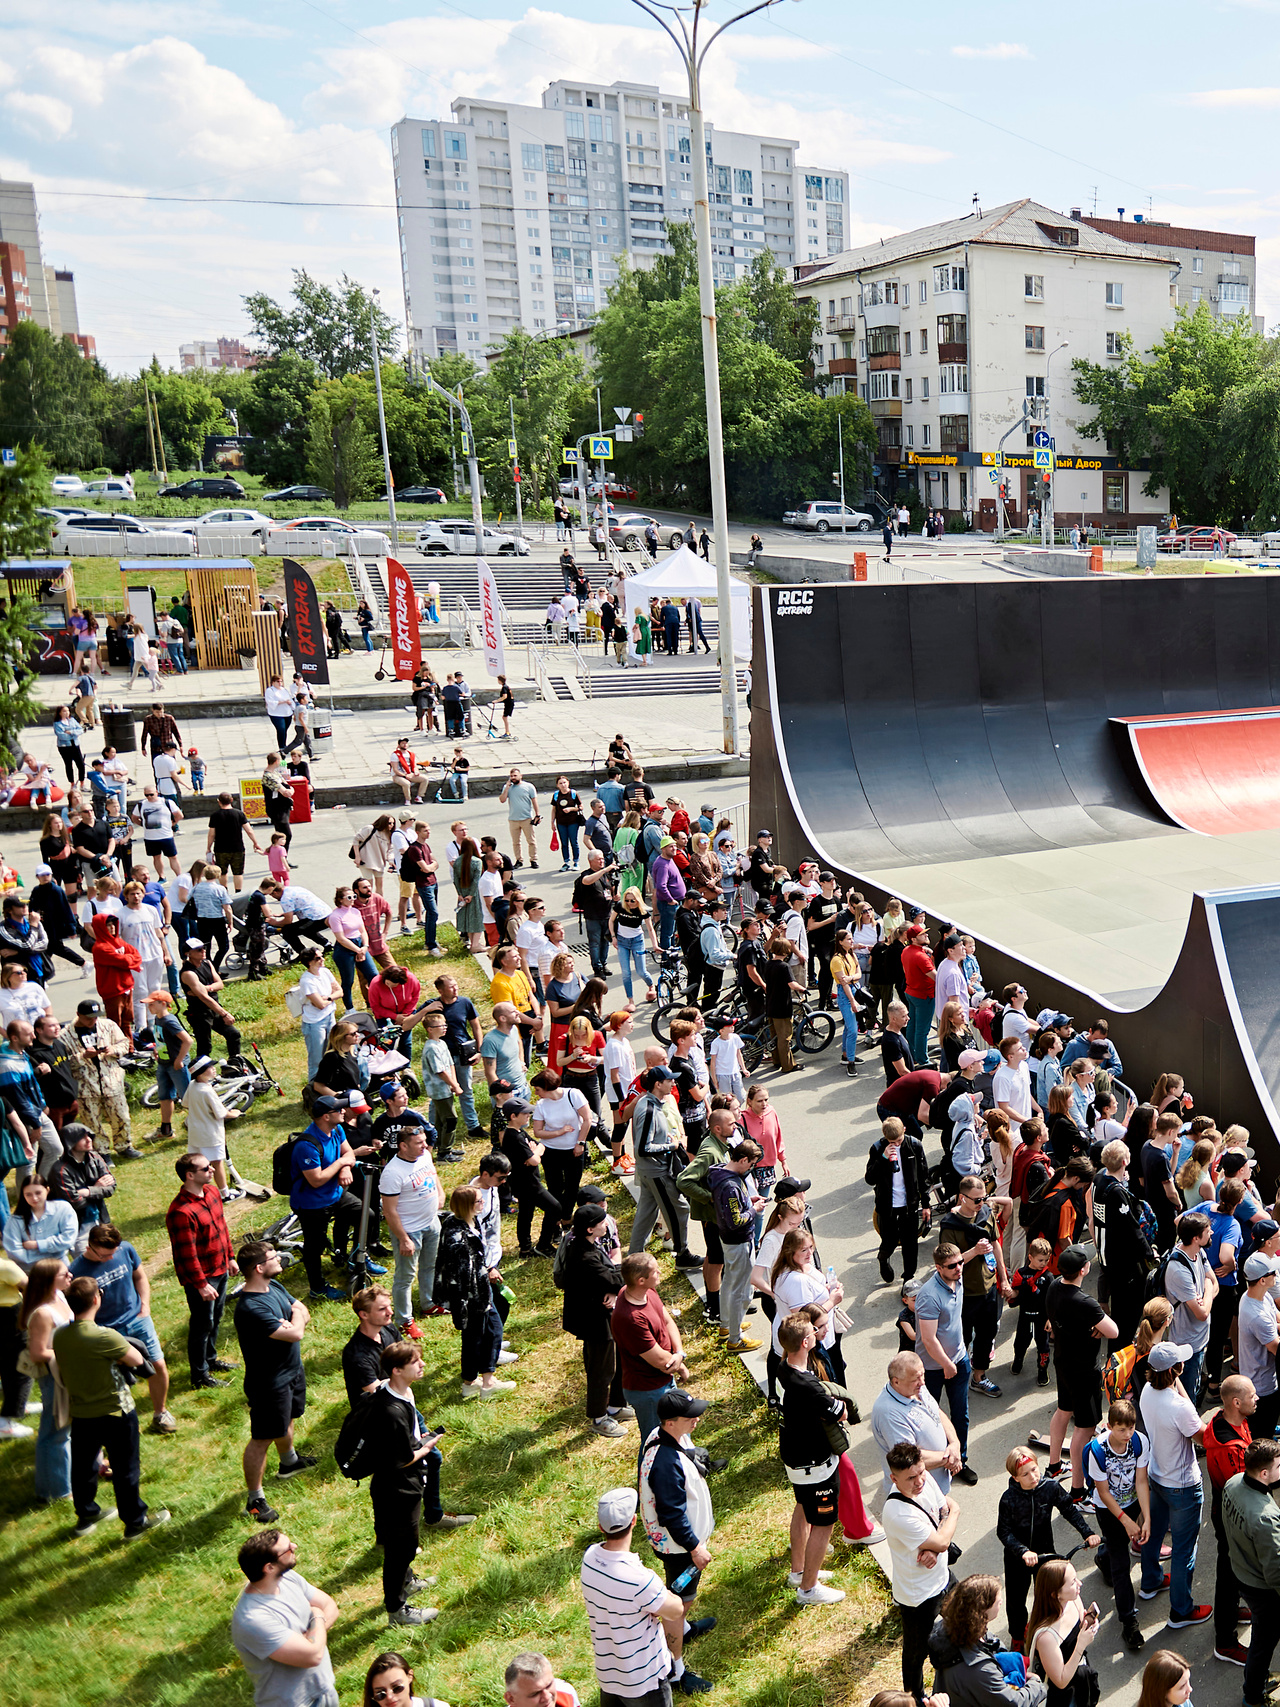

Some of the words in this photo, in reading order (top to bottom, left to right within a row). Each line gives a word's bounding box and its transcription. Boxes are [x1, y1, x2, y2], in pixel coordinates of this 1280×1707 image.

[6, 450, 14, 460] P
[945, 455, 958, 467] Двор
[1075, 458, 1102, 470] Двор
[778, 590, 814, 605] RCC
[293, 578, 317, 656] EXTREME
[395, 576, 414, 652] EXTREME
[482, 577, 497, 650] EXTREME
[776, 605, 813, 617] EXTREME
[302, 663, 318, 671] RCC
[399, 659, 413, 667] RCC
[383, 1124, 407, 1140] SUPER
[815, 1488, 834, 1497] NASA
